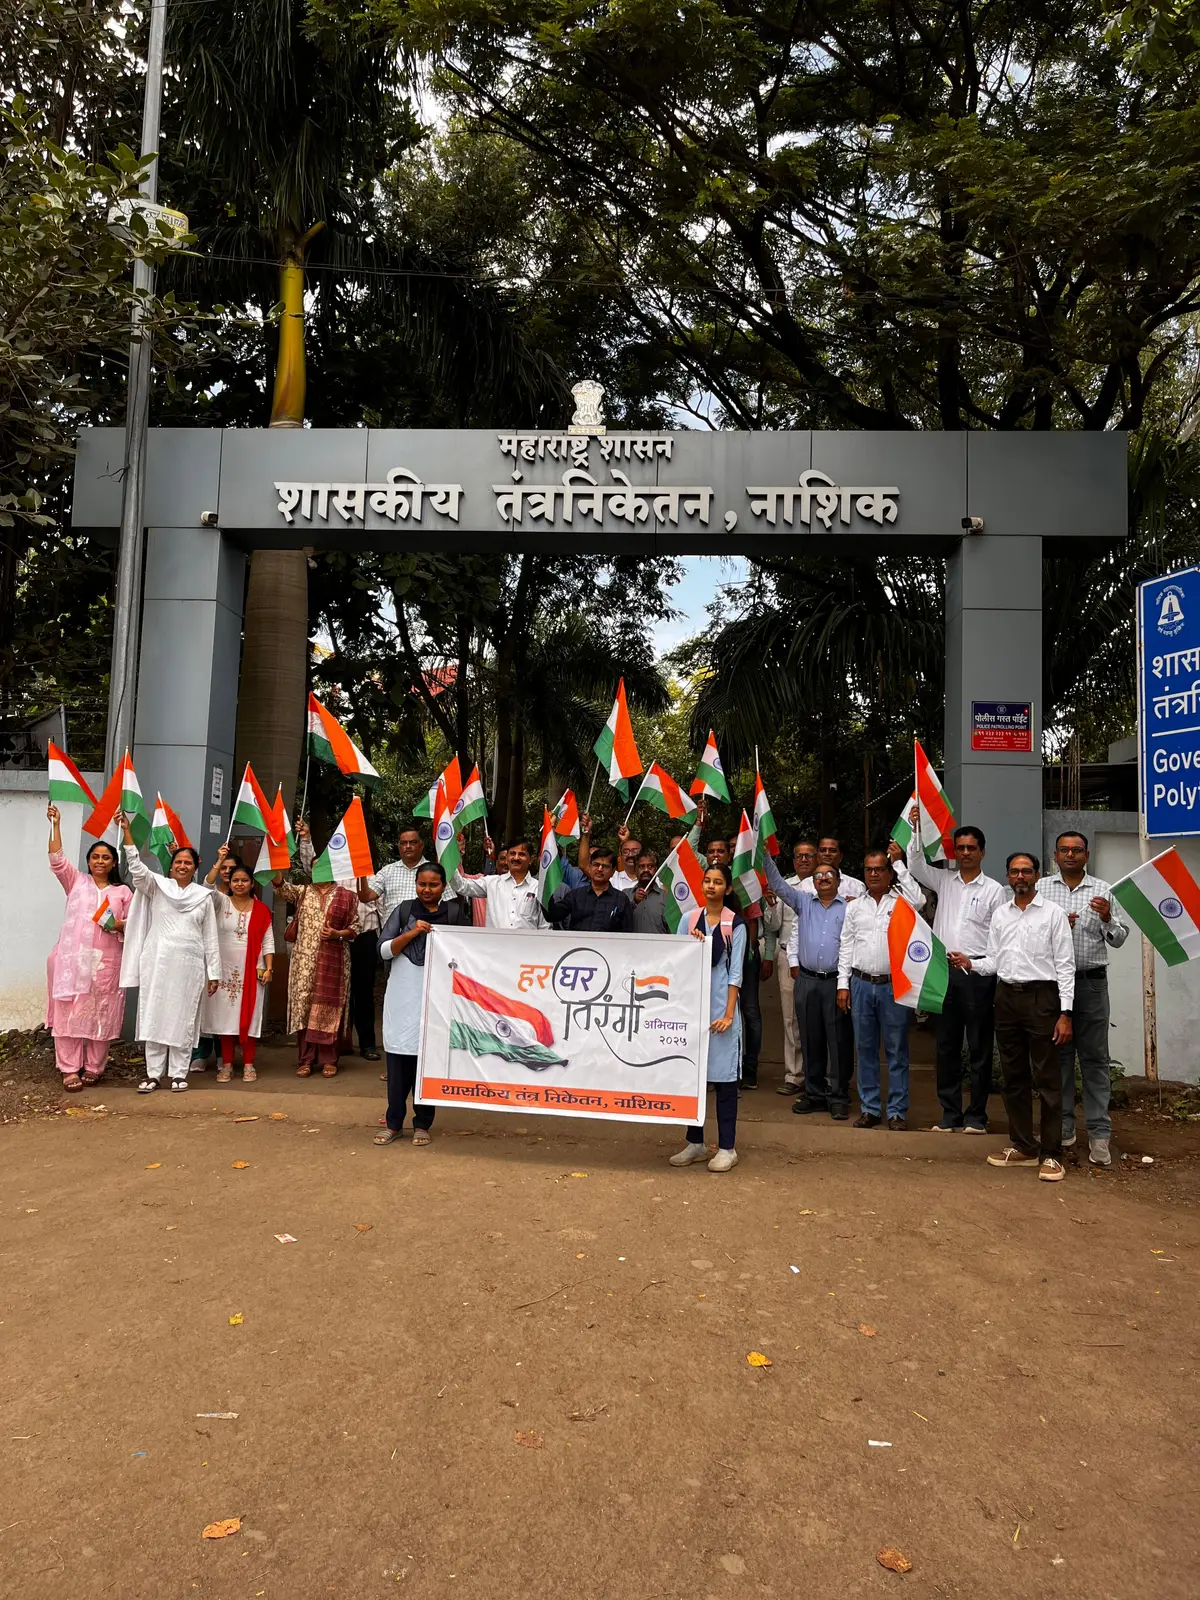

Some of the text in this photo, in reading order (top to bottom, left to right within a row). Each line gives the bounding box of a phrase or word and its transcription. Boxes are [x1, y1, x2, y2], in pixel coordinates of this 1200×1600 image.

[498, 435, 674, 467] महाराष्ट्र शासन
[273, 467, 464, 523] शासकीय
[745, 469, 901, 529] नाशिक
[975, 713, 996, 722] पोलीस
[997, 714, 1011, 723] गस्त
[1153, 781, 1200, 810] Poly
[517, 964, 598, 993] हर घर
[643, 1017, 688, 1032] अभियान
[659, 1035, 688, 1047] २०२५
[441, 1083, 511, 1100] शासकिय
[515, 1087, 540, 1102] तंत्र
